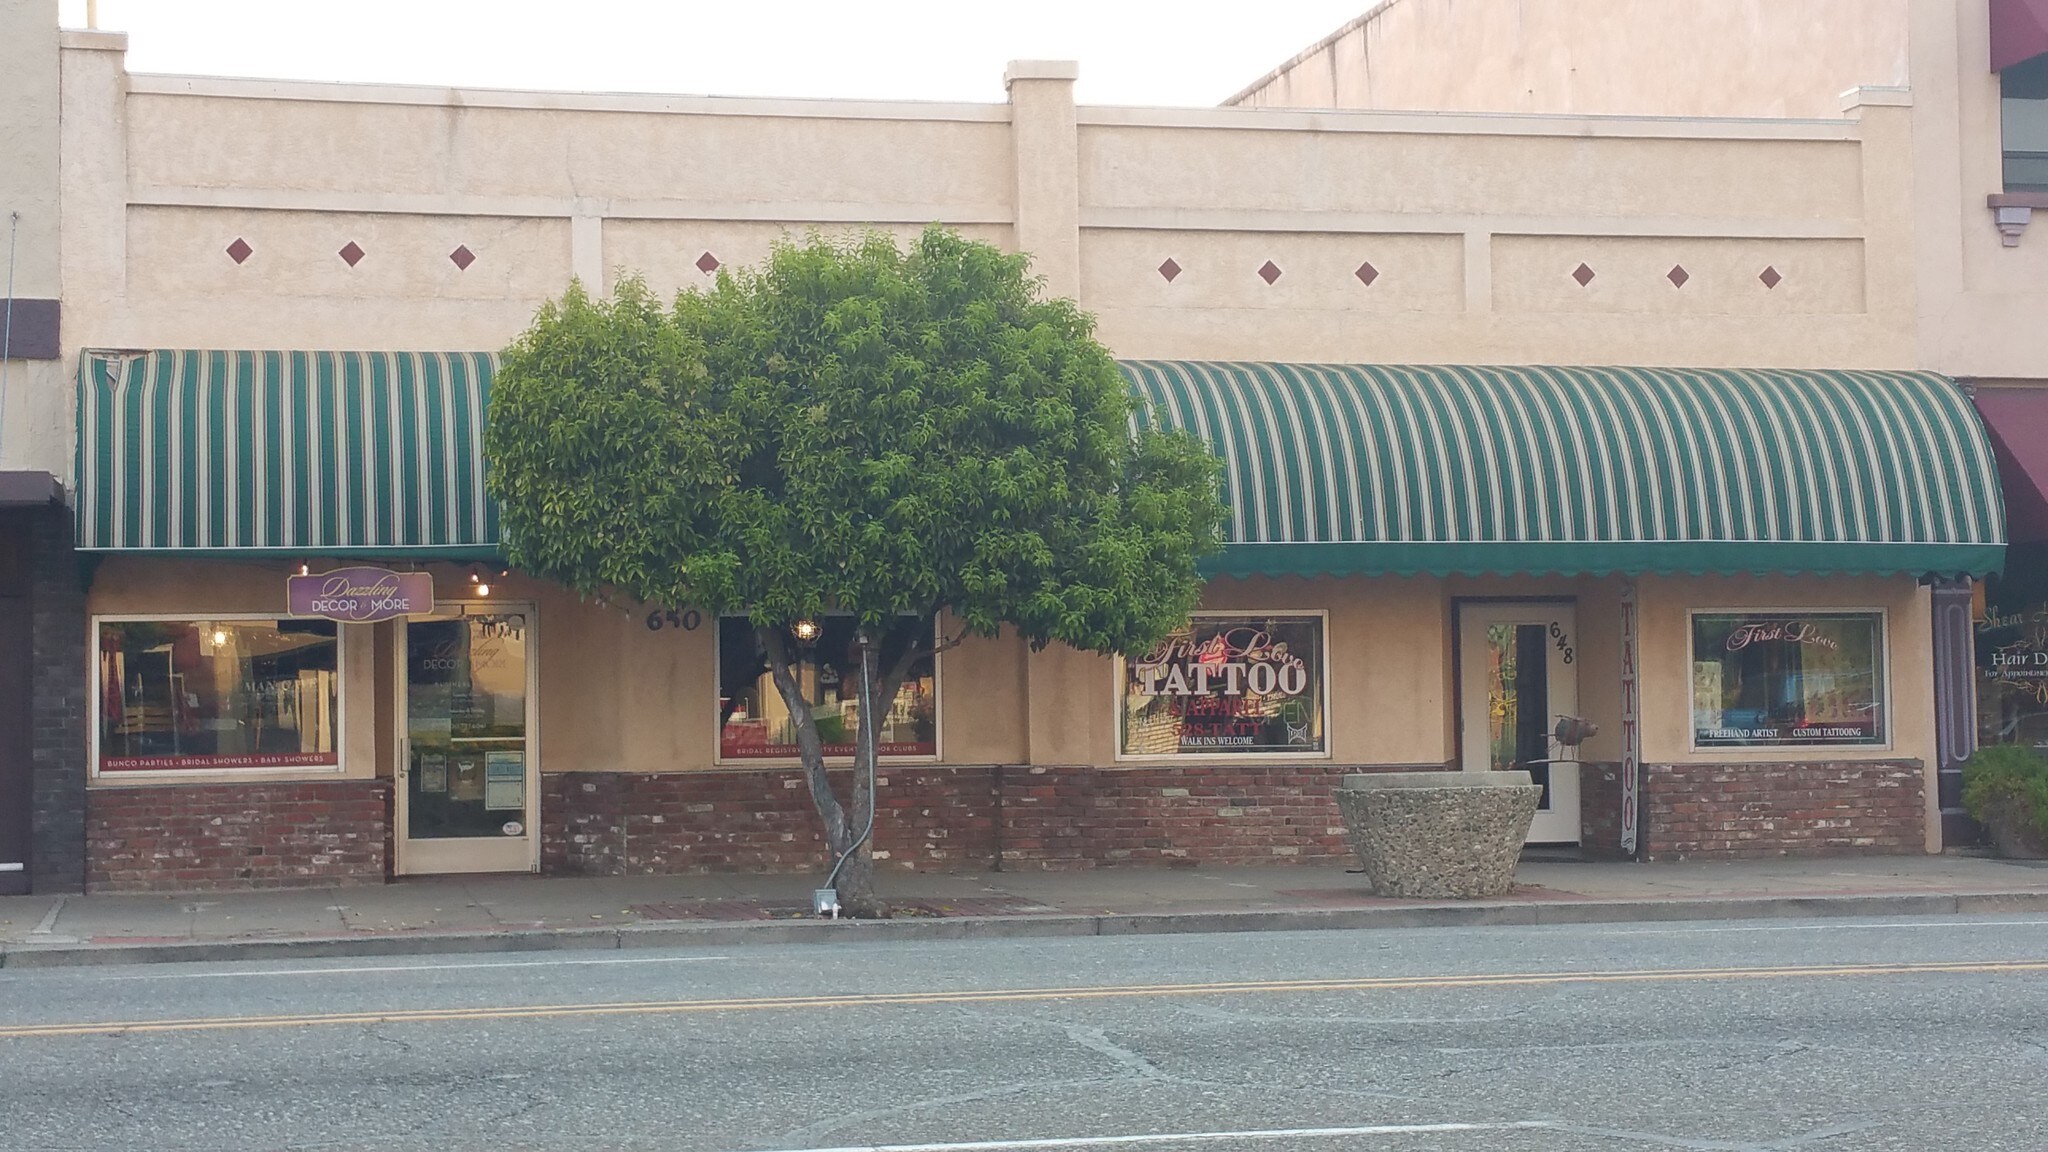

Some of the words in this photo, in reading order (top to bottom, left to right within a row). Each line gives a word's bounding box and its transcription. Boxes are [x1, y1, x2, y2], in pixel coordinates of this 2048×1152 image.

[311, 600, 358, 611] DECOR
[371, 598, 410, 610] MORE
[320, 574, 400, 616] Dazzling
[646, 609, 702, 631] 640
[1979, 605, 2023, 631] Shear
[1550, 621, 1573, 664] 648
[1725, 621, 1782, 651] First
[1783, 621, 1838, 650] Love
[1143, 629, 1227, 670] First
[1224, 627, 1305, 670] Love
[1991, 651, 2029, 666] Hair
[1135, 663, 1307, 696] TATTOO
[1185, 699, 1265, 717] APPAREL
[1621, 602, 1635, 831] TATTOO
[1181, 736, 1202, 746] WALK
[1203, 736, 1216, 745] INS
[1217, 736, 1254, 745] WELCOME
[1709, 728, 1750, 738] FREEHAND
[1751, 728, 1779, 738] ARTIST
[1792, 728, 1822, 737] CUSTOM
[1822, 727, 1862, 737] TATTOOING
[181, 758, 211, 766] BRIDAL
[213, 757, 253, 765] SHOWERS
[260, 756, 282, 764] BABY
[284, 755, 324, 764] SHOWERS
